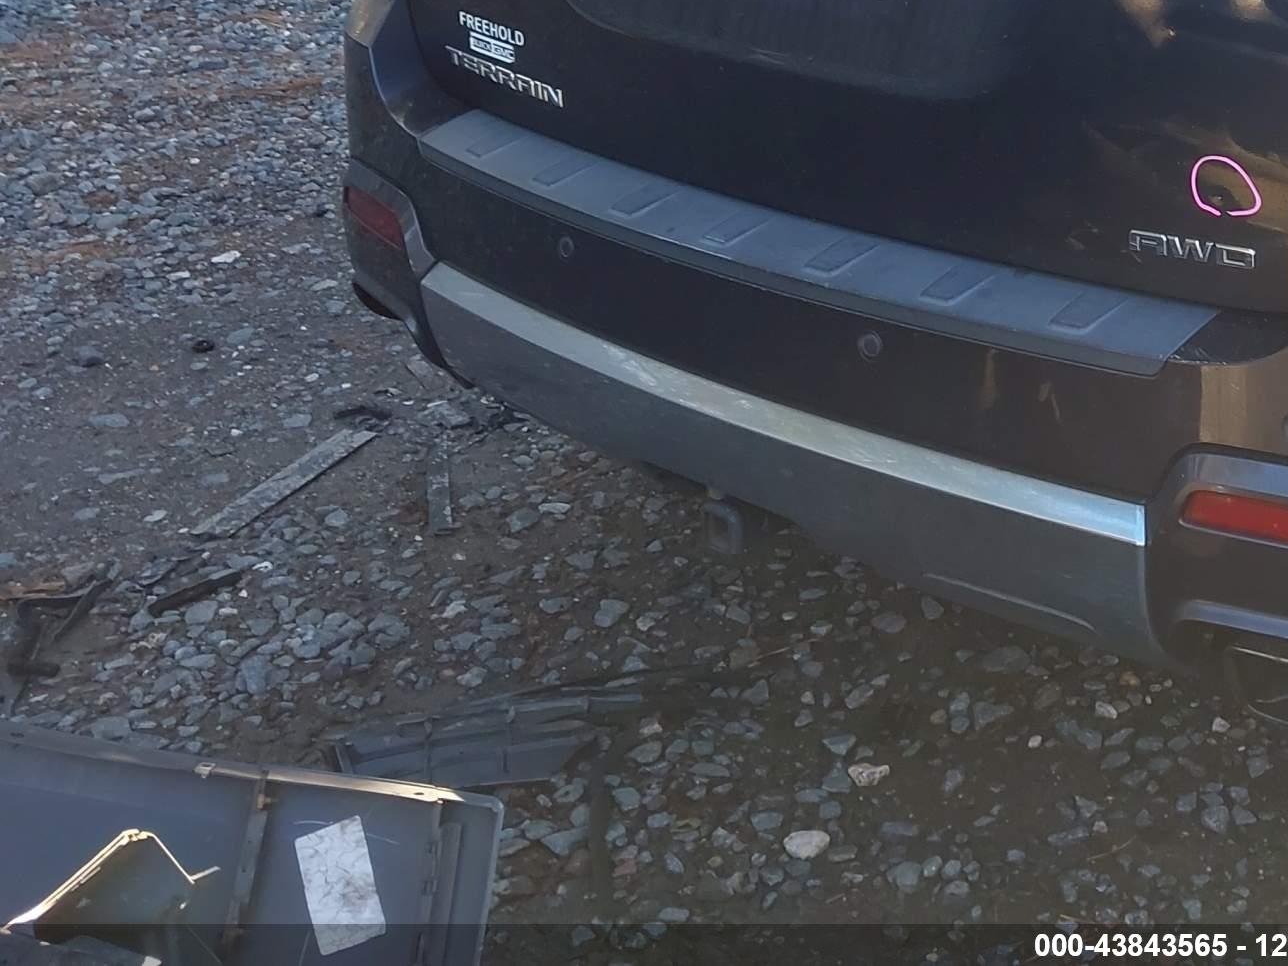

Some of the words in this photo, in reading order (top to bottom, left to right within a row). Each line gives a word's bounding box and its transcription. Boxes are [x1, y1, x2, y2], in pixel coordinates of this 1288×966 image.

[459, 10, 525, 46] FREEHOLD
[445, 45, 564, 108] TERRAIN
[1129, 229, 1256, 269] AWD
